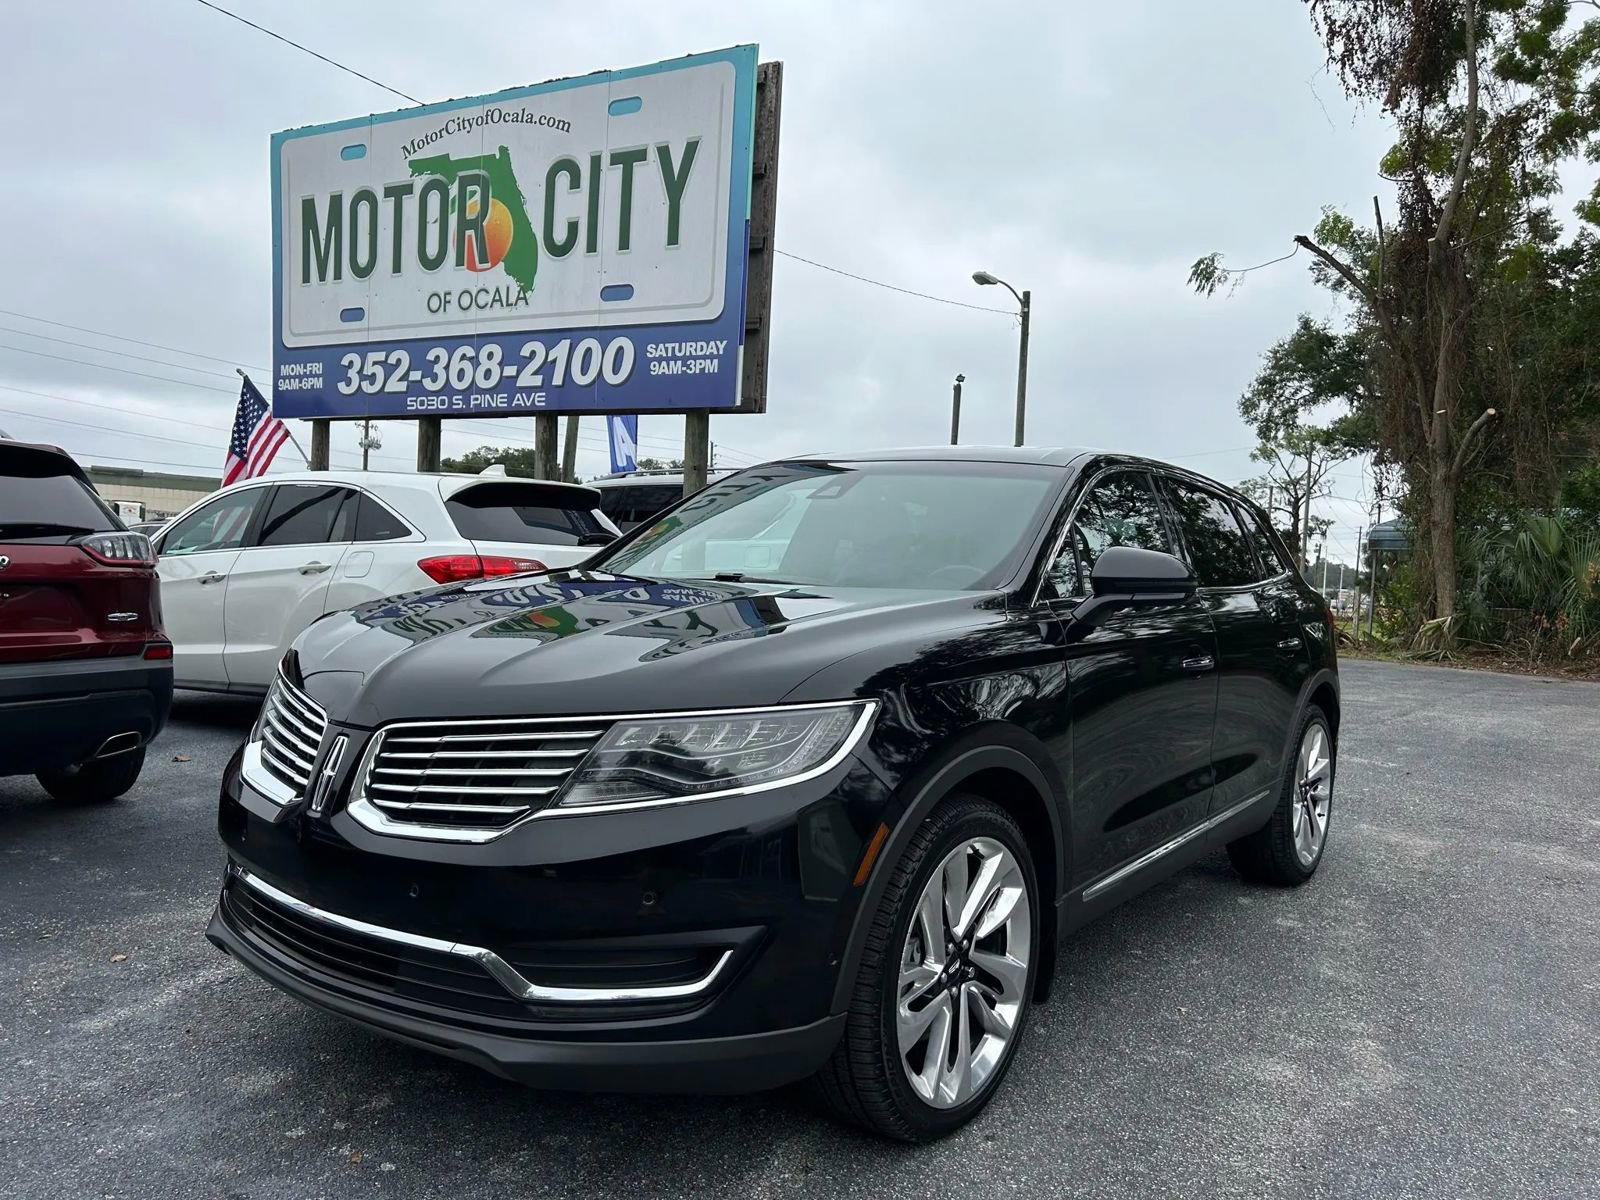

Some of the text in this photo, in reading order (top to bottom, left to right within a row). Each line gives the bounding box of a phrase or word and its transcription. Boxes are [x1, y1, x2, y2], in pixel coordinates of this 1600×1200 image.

[400, 108, 572, 160] MotorCityofOcala.com
[301, 135, 702, 285] MOTOR CITY
[427, 286, 529, 313] OF OCALA
[646, 340, 728, 358] SATURDAY
[280, 363, 322, 376] MON-FRI
[337, 337, 635, 394] 352-368-2100
[650, 359, 718, 376] 9AM-3PM
[278, 377, 323, 391] 9AM-6PM
[407, 392, 546, 410] 5030 S. PINE AVE
